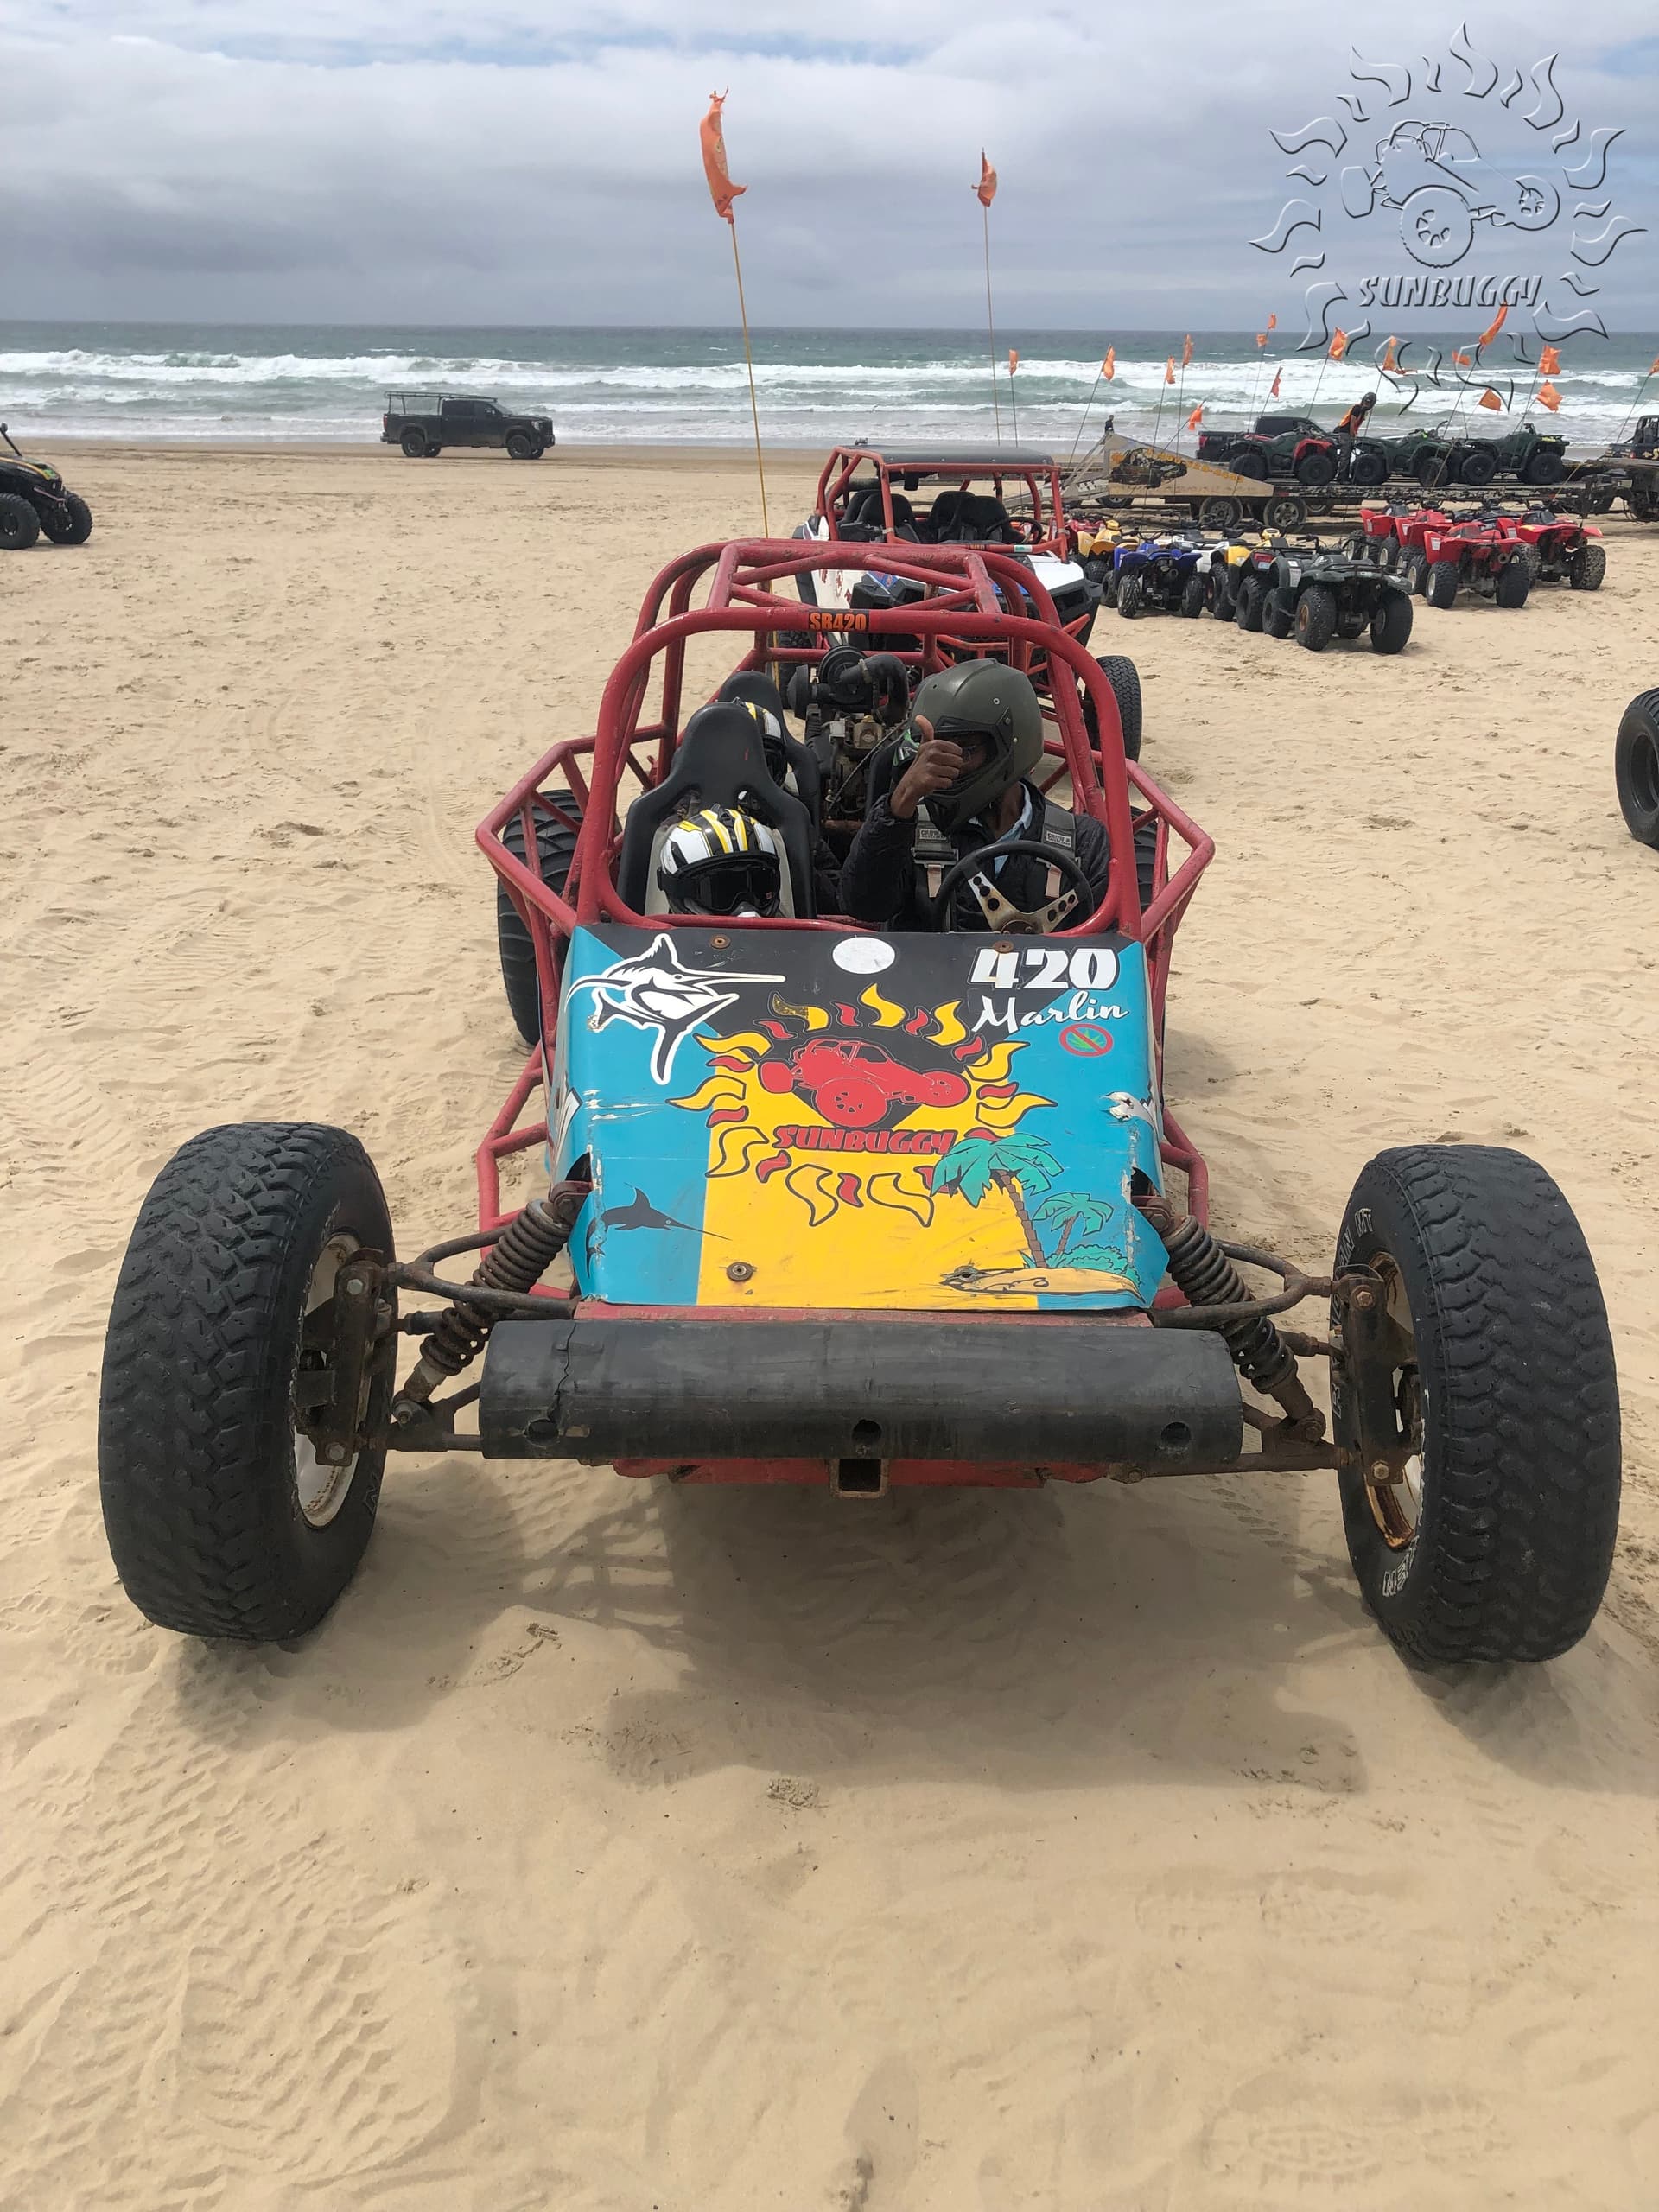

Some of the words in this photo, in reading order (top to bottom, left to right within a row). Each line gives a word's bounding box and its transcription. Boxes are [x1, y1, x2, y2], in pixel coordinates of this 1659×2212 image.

[809, 612, 867, 632] SB420
[970, 948, 1117, 989] 420
[971, 990, 1130, 1033] Marlin
[772, 1125, 957, 1154] SUNBUGGY
